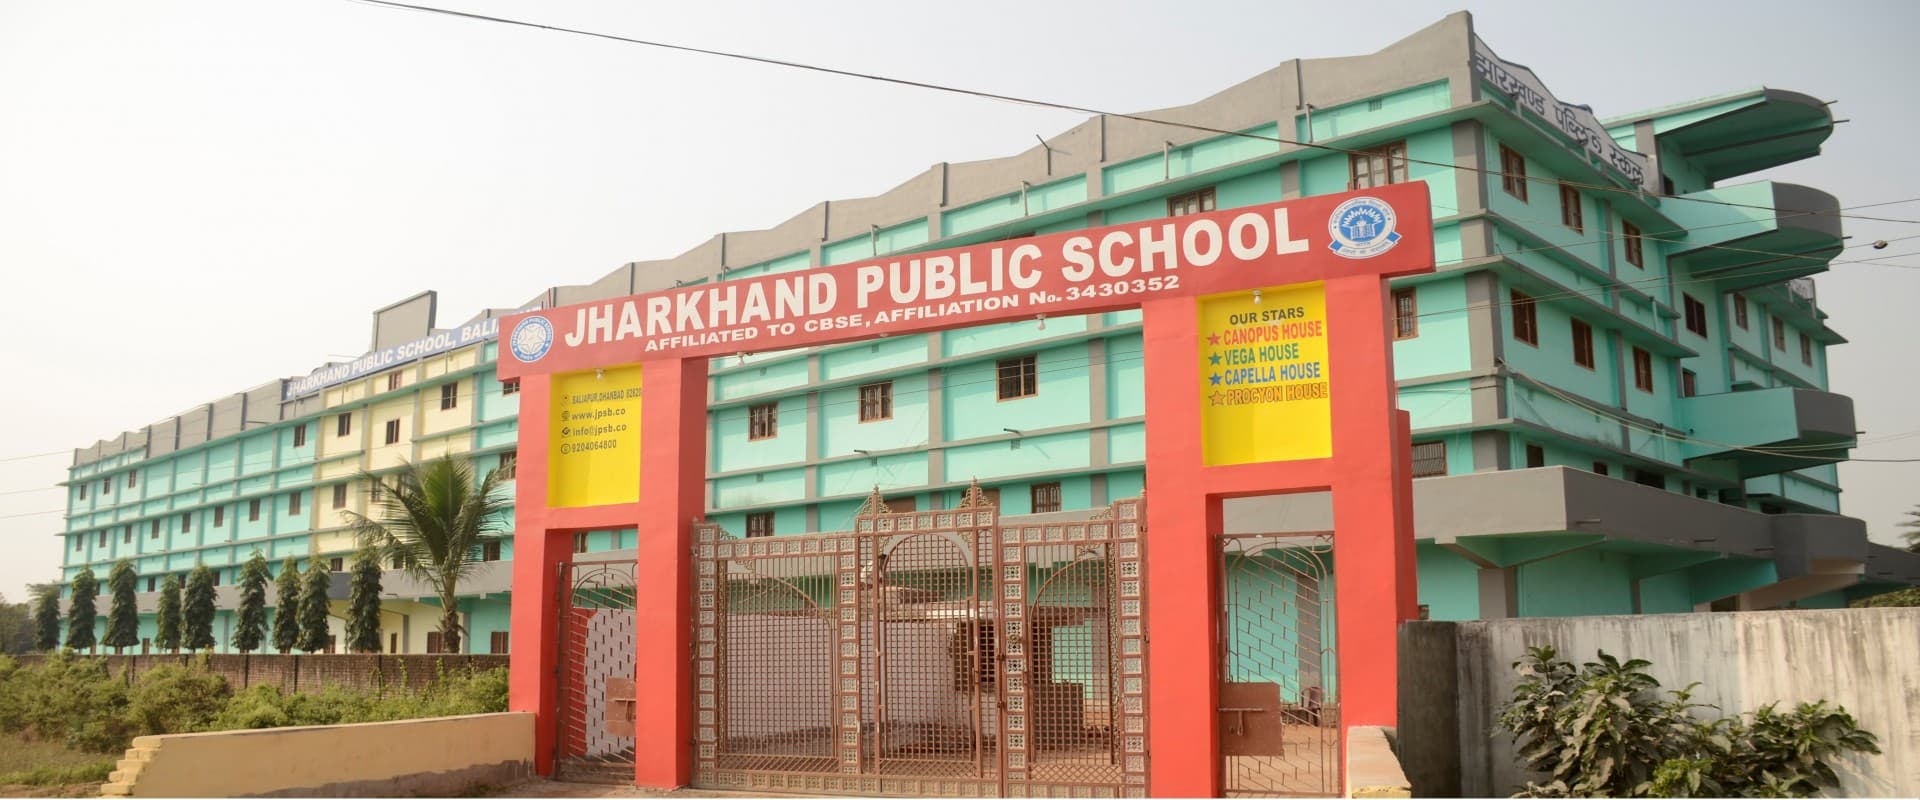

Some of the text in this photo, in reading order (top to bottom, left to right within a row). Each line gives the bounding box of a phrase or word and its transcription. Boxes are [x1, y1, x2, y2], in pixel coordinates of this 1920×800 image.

[564, 207, 1309, 348] JHARKHAND PUBLIC SCHOOL
[645, 327, 758, 352] AFFILIATED
[767, 322, 796, 337] TO
[1029, 291, 1063, 306] No.
[1066, 275, 1180, 302] 3430352
[1229, 306, 1305, 326] OUR STARS
[1223, 320, 1323, 346] CANOPUS HOUSE
[286, 318, 499, 397] JHARKHAND PUBLIC SCHOOL, BALI
[1224, 342, 1300, 366] VEGA HOUSE
[1224, 362, 1321, 385] CAPELLA HOUSE
[1226, 382, 1329, 406] PROCYON HOUSE
[571, 407, 626, 421] www.jpsb.co
